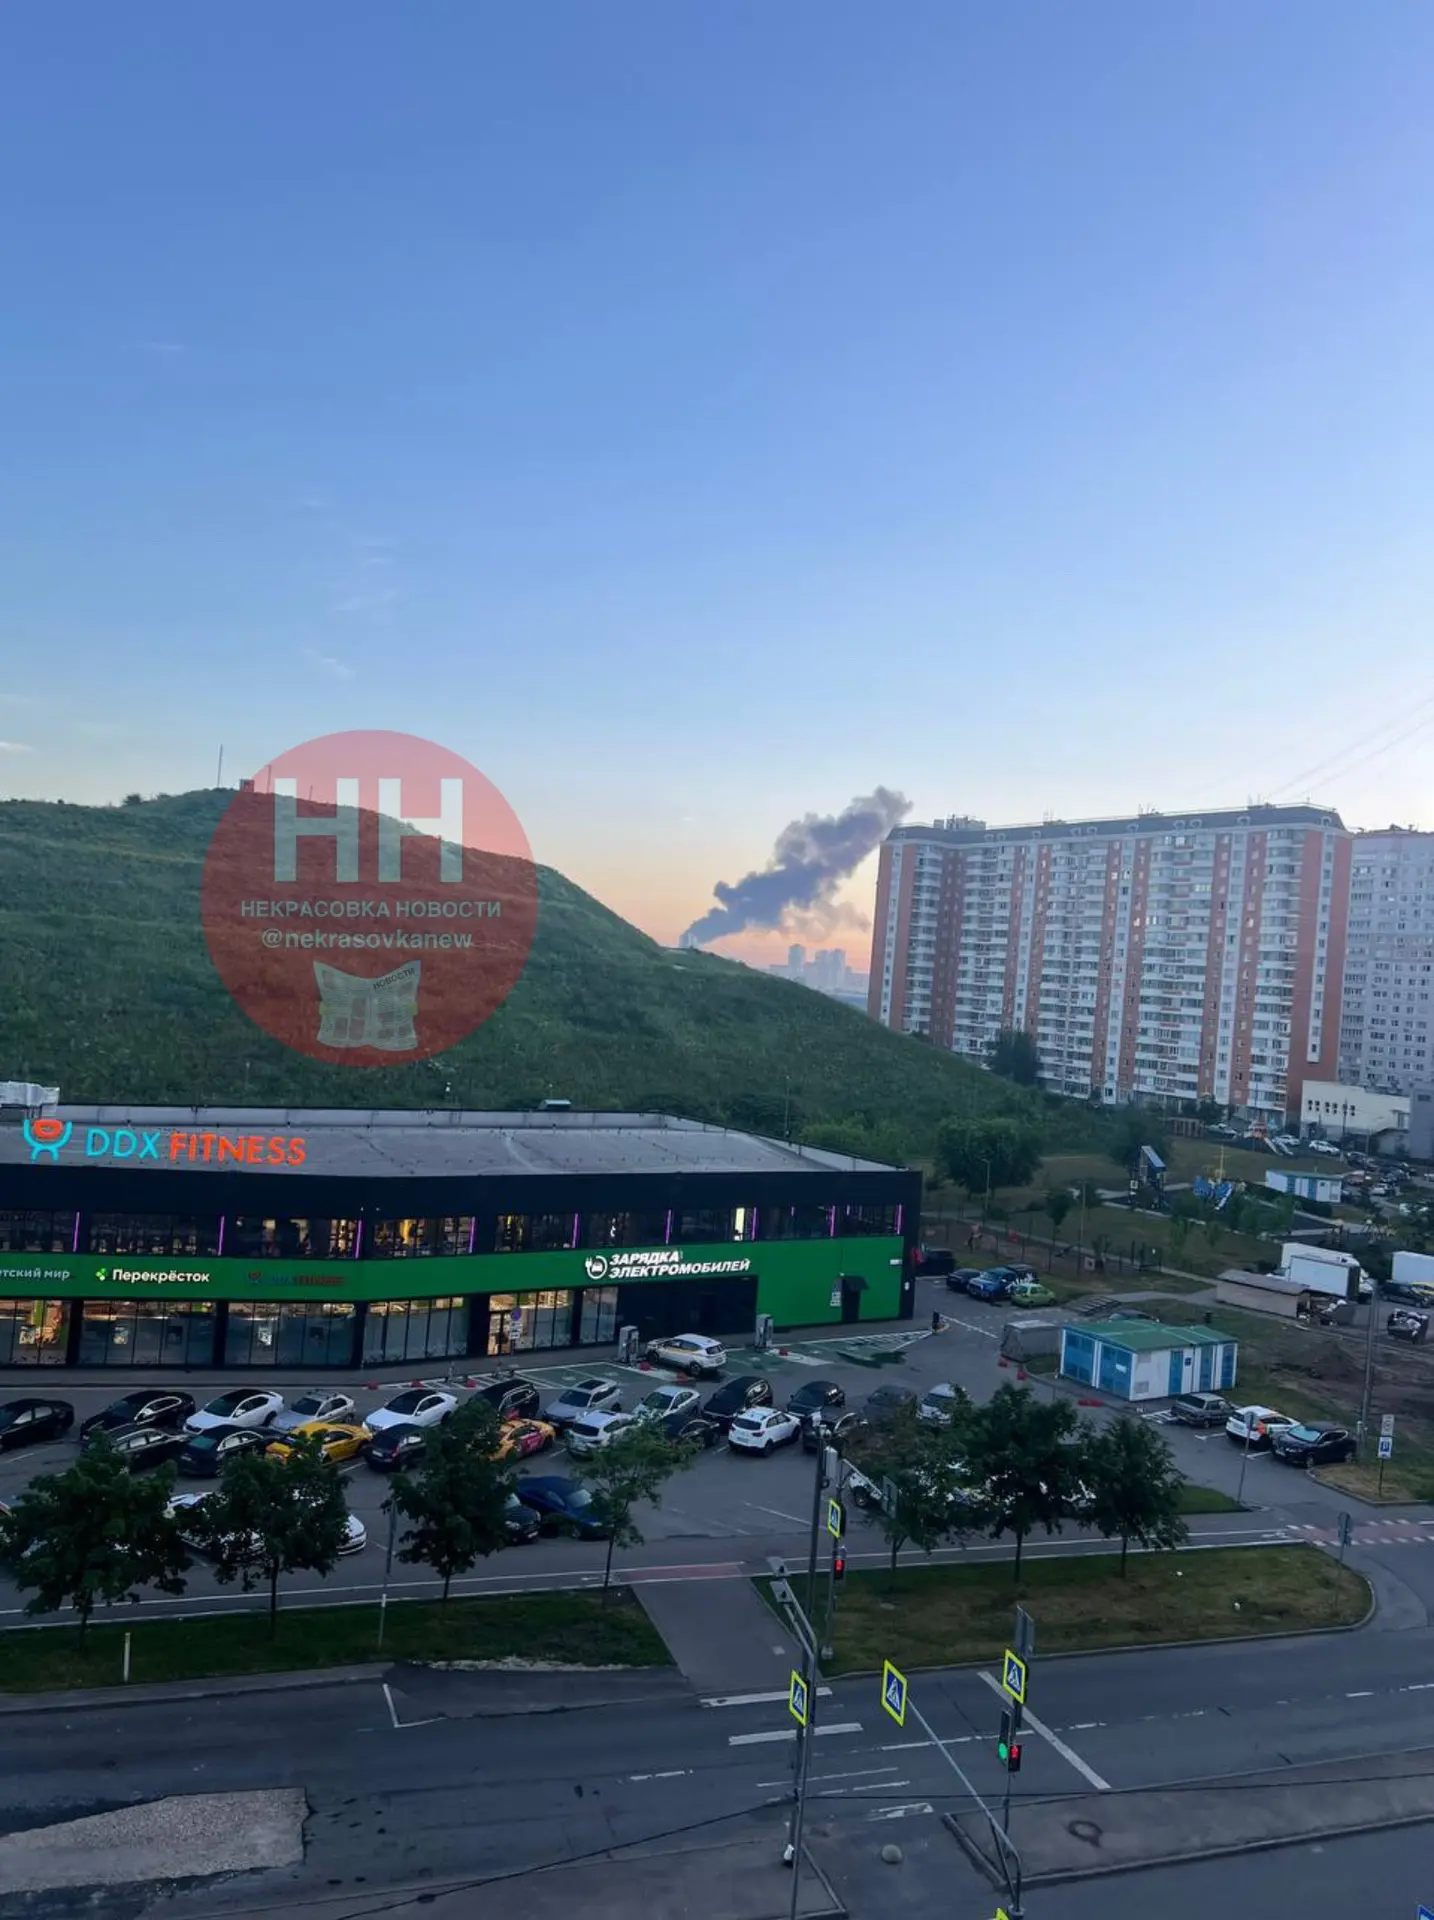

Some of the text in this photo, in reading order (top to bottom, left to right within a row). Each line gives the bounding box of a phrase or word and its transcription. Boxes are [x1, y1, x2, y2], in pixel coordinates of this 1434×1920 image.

[85, 1127, 307, 1165] DDX FITNESS
[609, 1250, 680, 1266] ЗАРЯДКА
[44, 1269, 71, 1281] мир
[112, 1268, 210, 1284] Перекрёсток
[608, 1258, 751, 1279] ЭЛЕКТРОМОБИЛЕЙ
